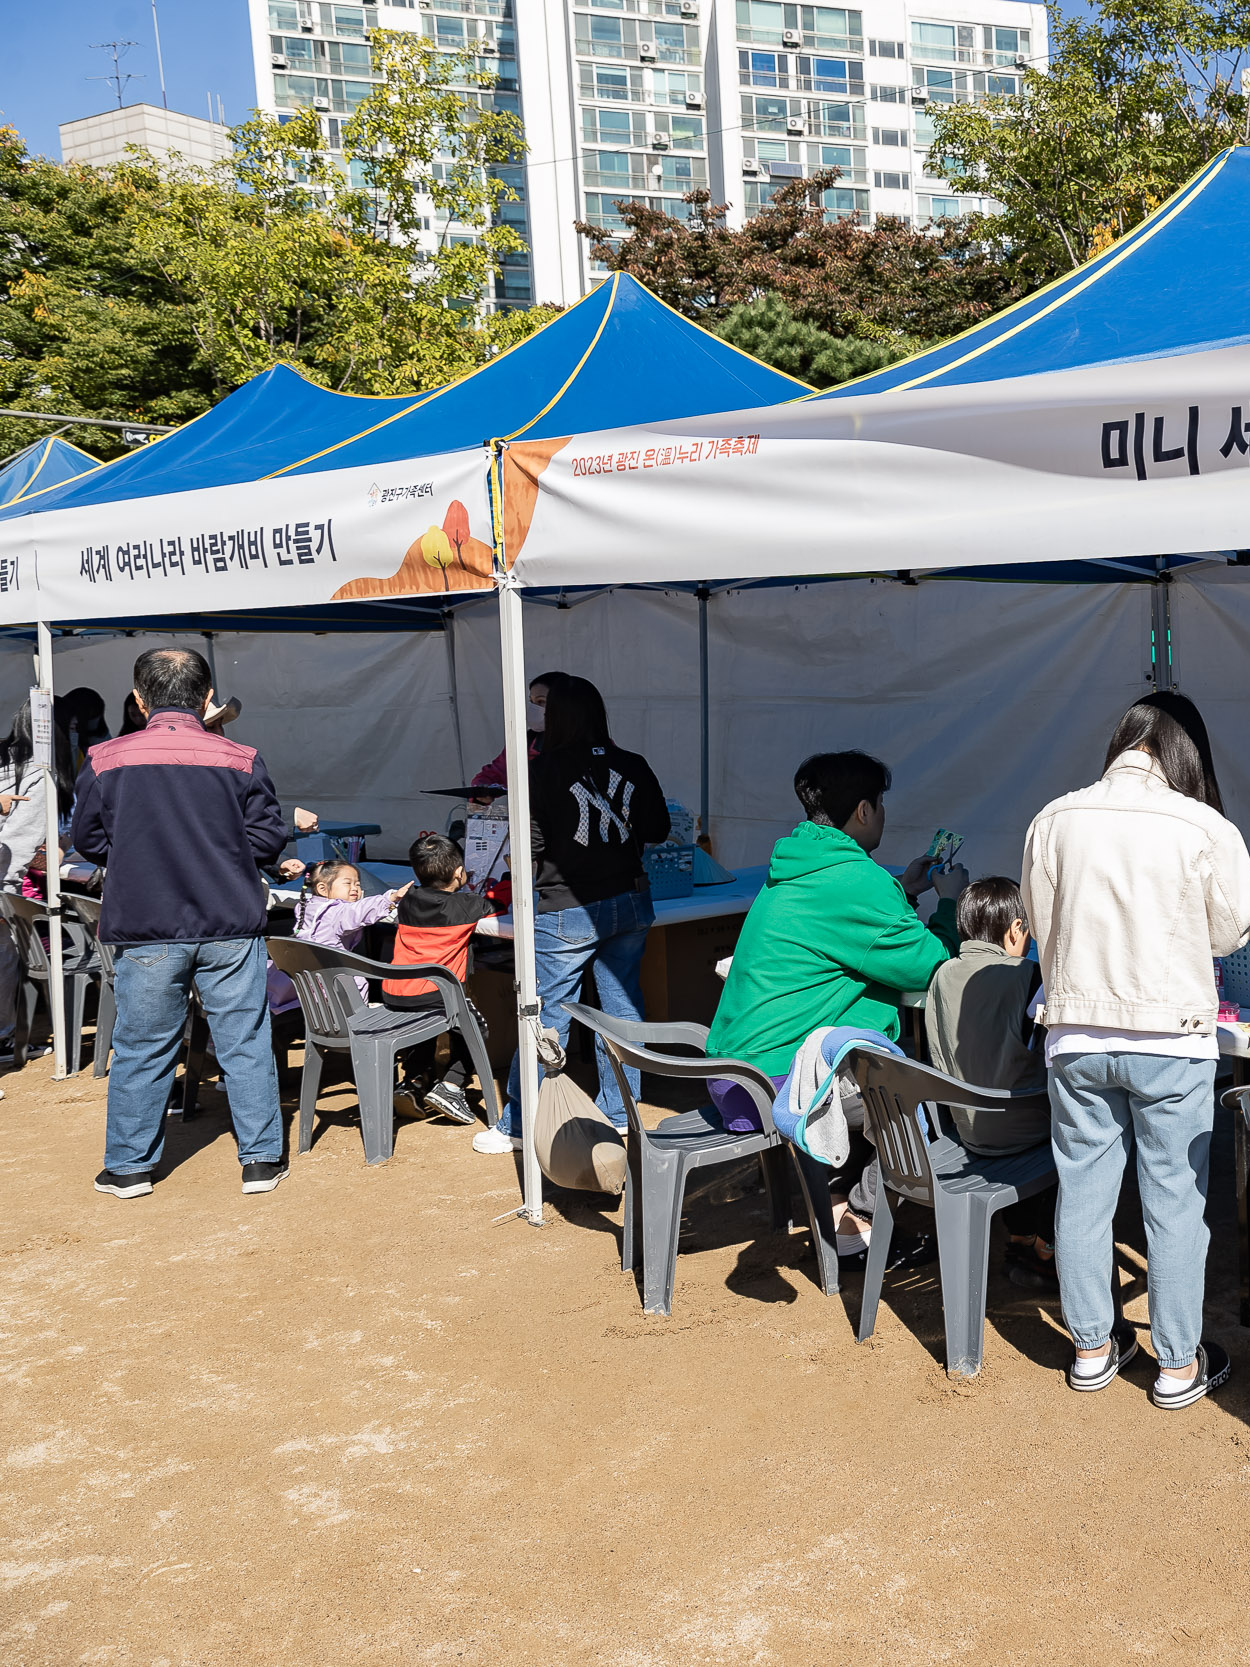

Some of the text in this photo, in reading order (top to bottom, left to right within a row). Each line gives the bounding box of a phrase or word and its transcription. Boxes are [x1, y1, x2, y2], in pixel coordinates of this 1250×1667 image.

[571, 453, 613, 477] 2023년
[615, 449, 641, 472] 광진
[705, 433, 760, 460] 가족축제
[1100, 404, 1200, 481] 미니
[380, 481, 434, 503] 광진구가족센터
[79, 518, 337, 583] 세계 여러나라 바람개비 만들기
[569, 767, 636, 848] NY
